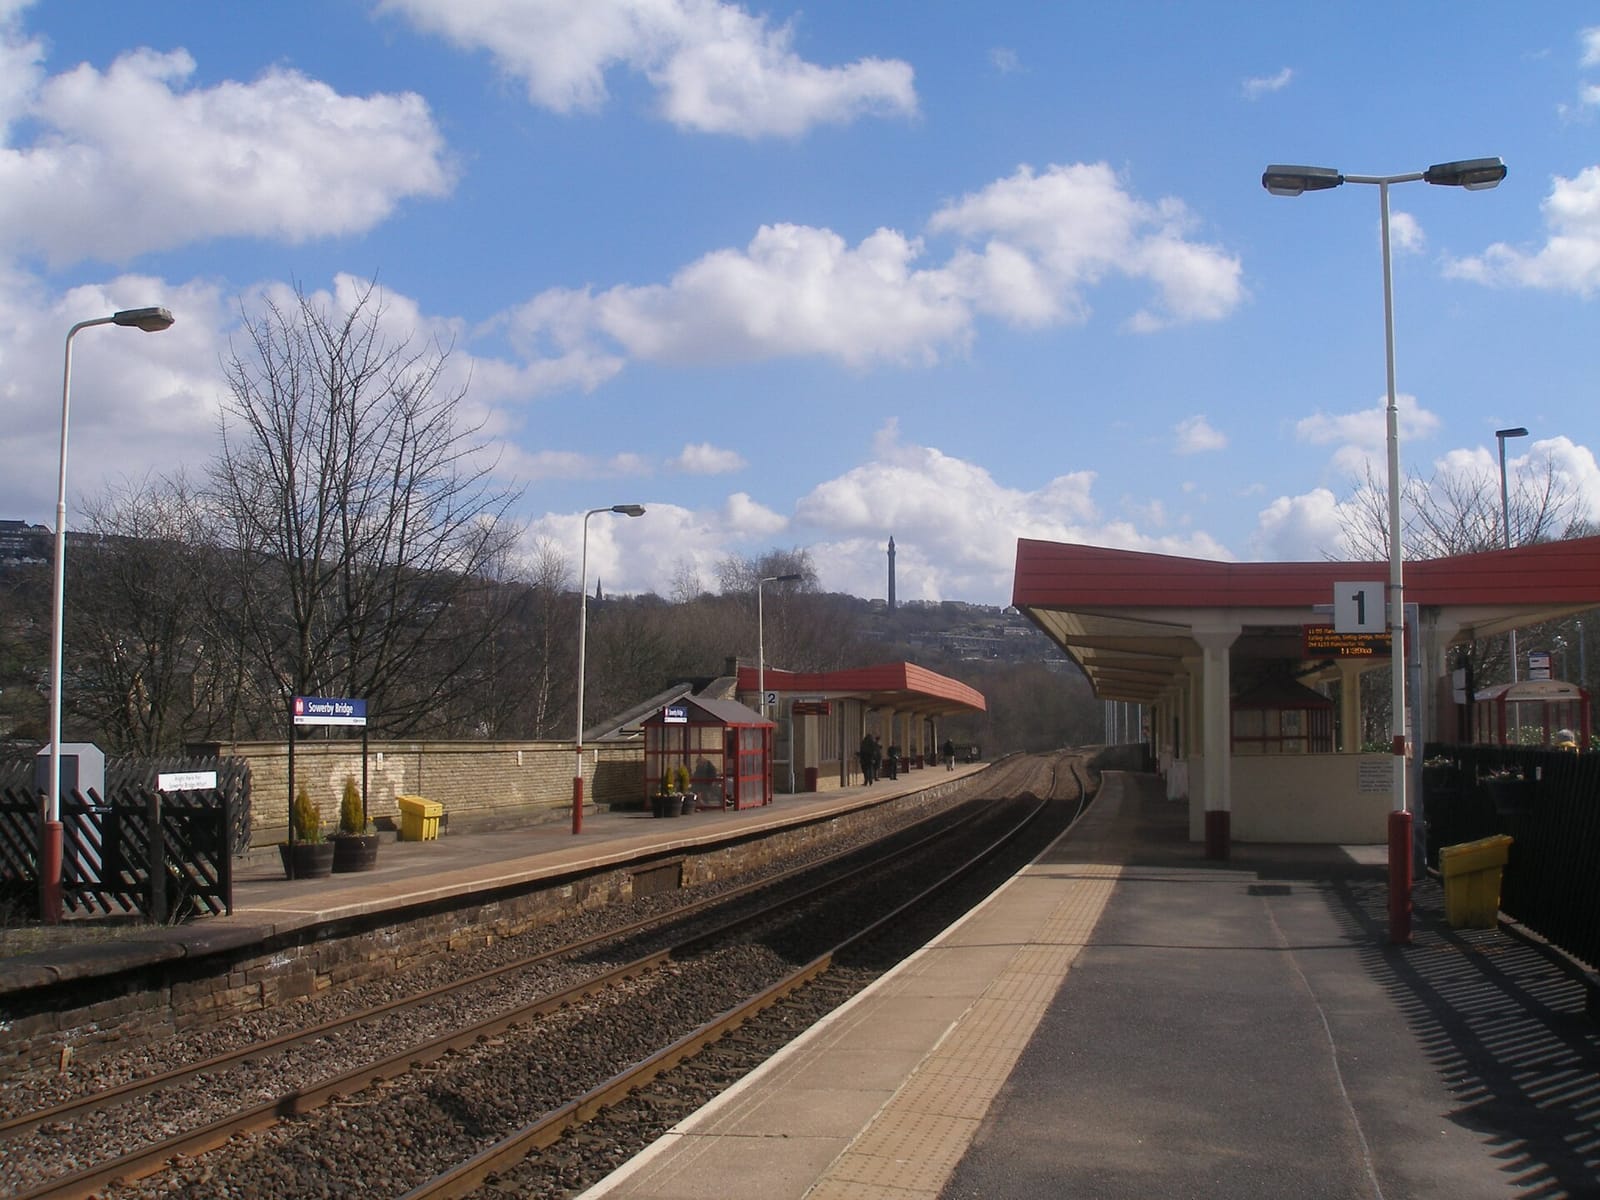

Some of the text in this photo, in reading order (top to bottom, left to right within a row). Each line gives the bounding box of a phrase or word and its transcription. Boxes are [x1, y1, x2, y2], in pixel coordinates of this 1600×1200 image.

[1352, 590, 1365, 625] 1
[767, 693, 776, 704] 2
[308, 702, 334, 716] Sowerby
[335, 703, 353, 716] Bridge
